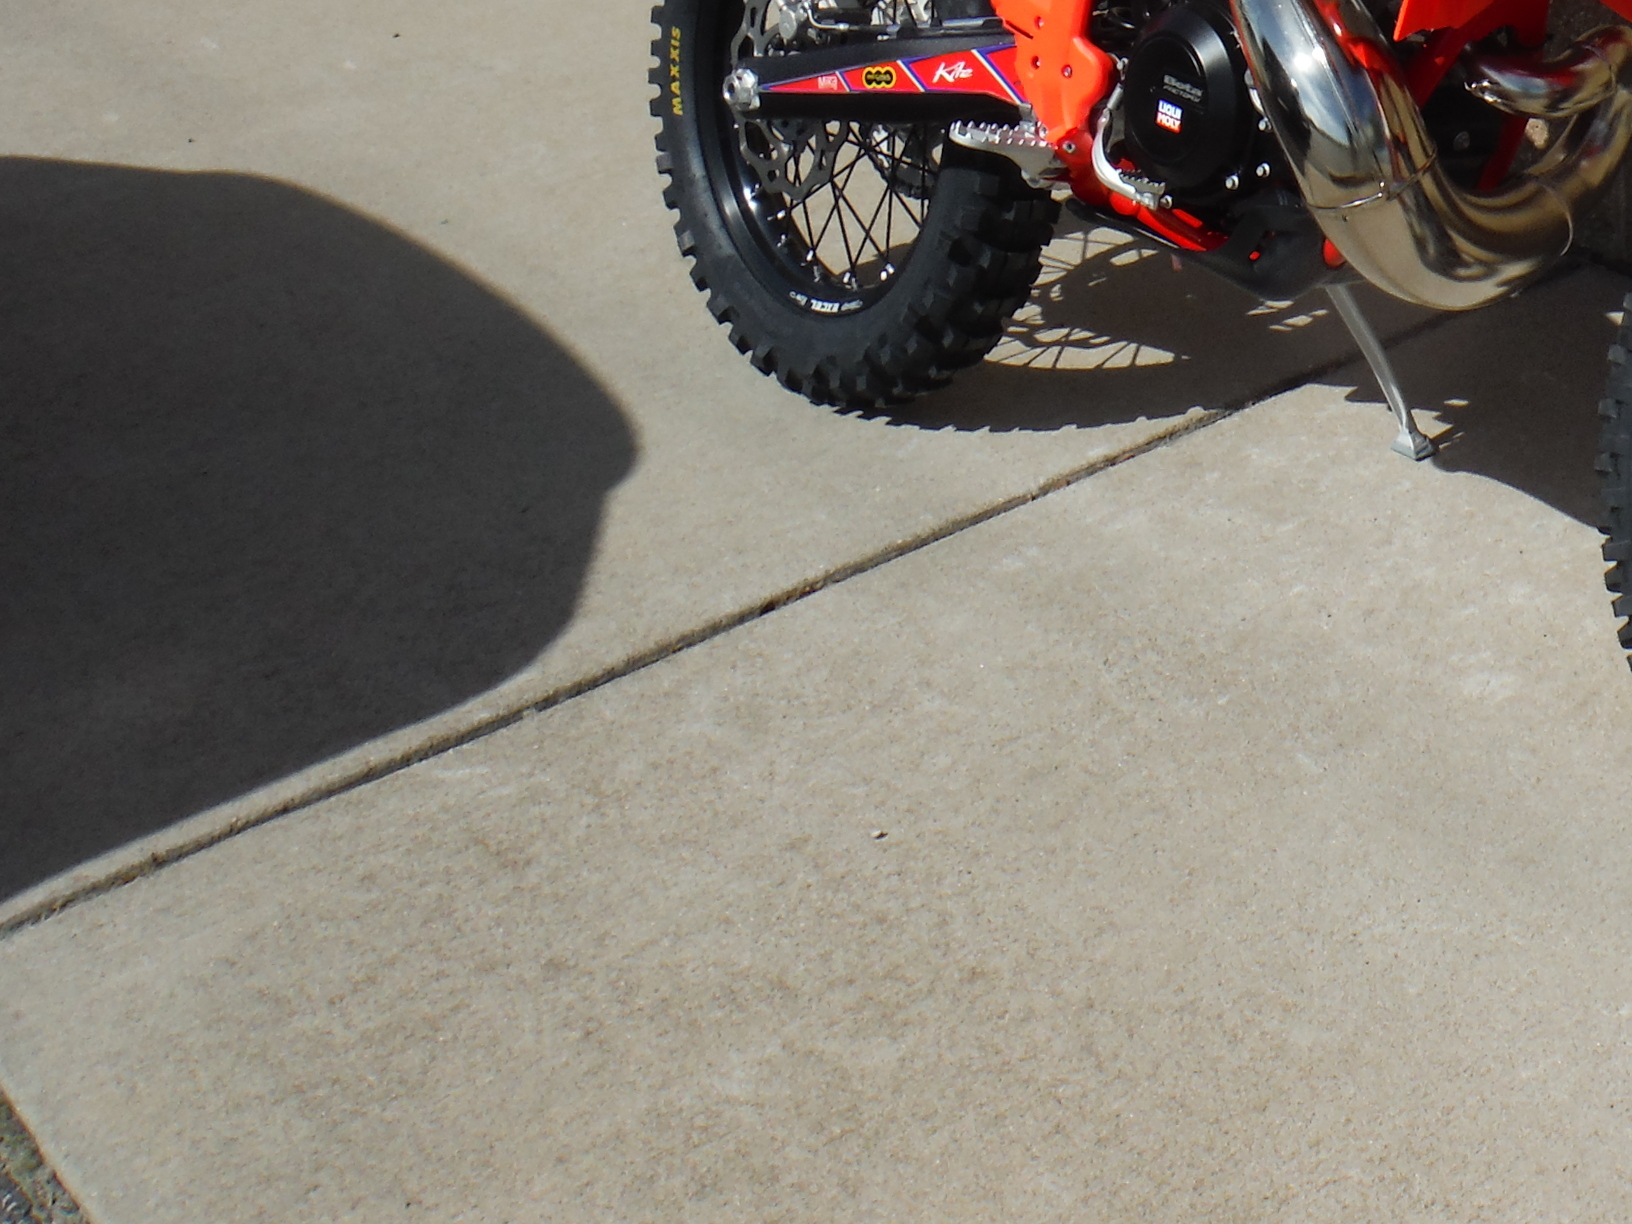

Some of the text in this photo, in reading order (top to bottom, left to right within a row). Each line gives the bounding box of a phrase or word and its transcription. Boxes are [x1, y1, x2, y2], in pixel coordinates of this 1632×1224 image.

[669, 26, 683, 117] MAXXIS
[1155, 111, 1182, 129] MOLY
[1157, 99, 1183, 120] LIQUI
